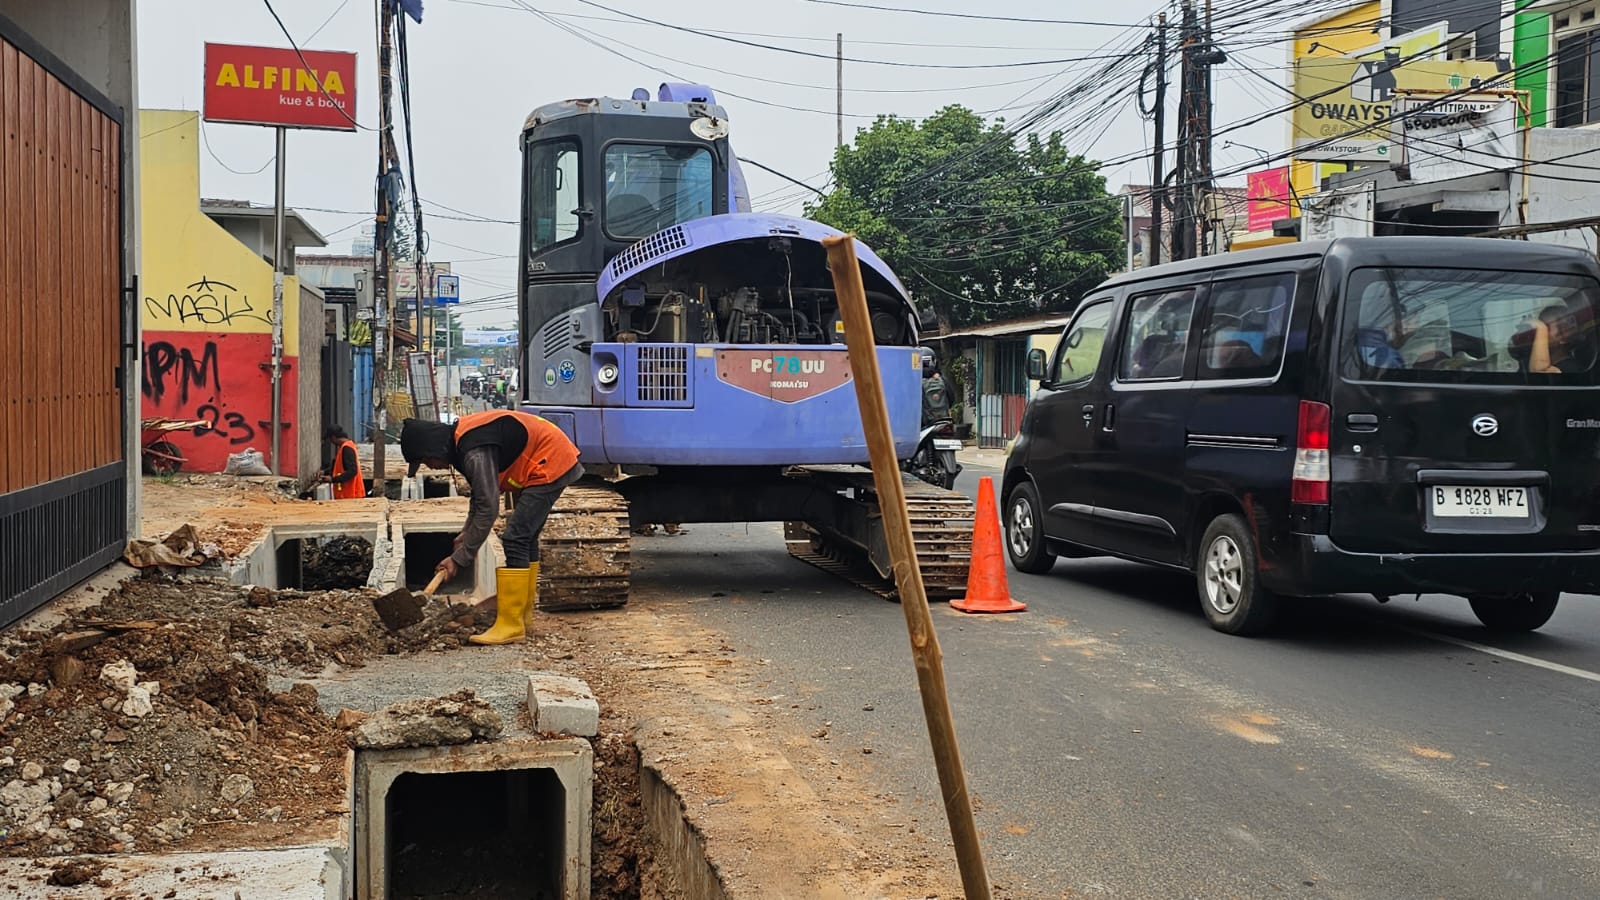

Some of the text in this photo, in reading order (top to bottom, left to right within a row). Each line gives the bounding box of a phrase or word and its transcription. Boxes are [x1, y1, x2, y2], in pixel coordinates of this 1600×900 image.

[215, 62, 345, 95] ALFINA
[279, 94, 302, 106] kue
[305, 96, 315, 107] &
[1439, 102, 1477, 113] TITIPAN
[751, 356, 825, 374] PC78UU
[194, 404, 255, 445] 23
[1436, 487, 1445, 505] B
[1455, 488, 1491, 506] 1828
